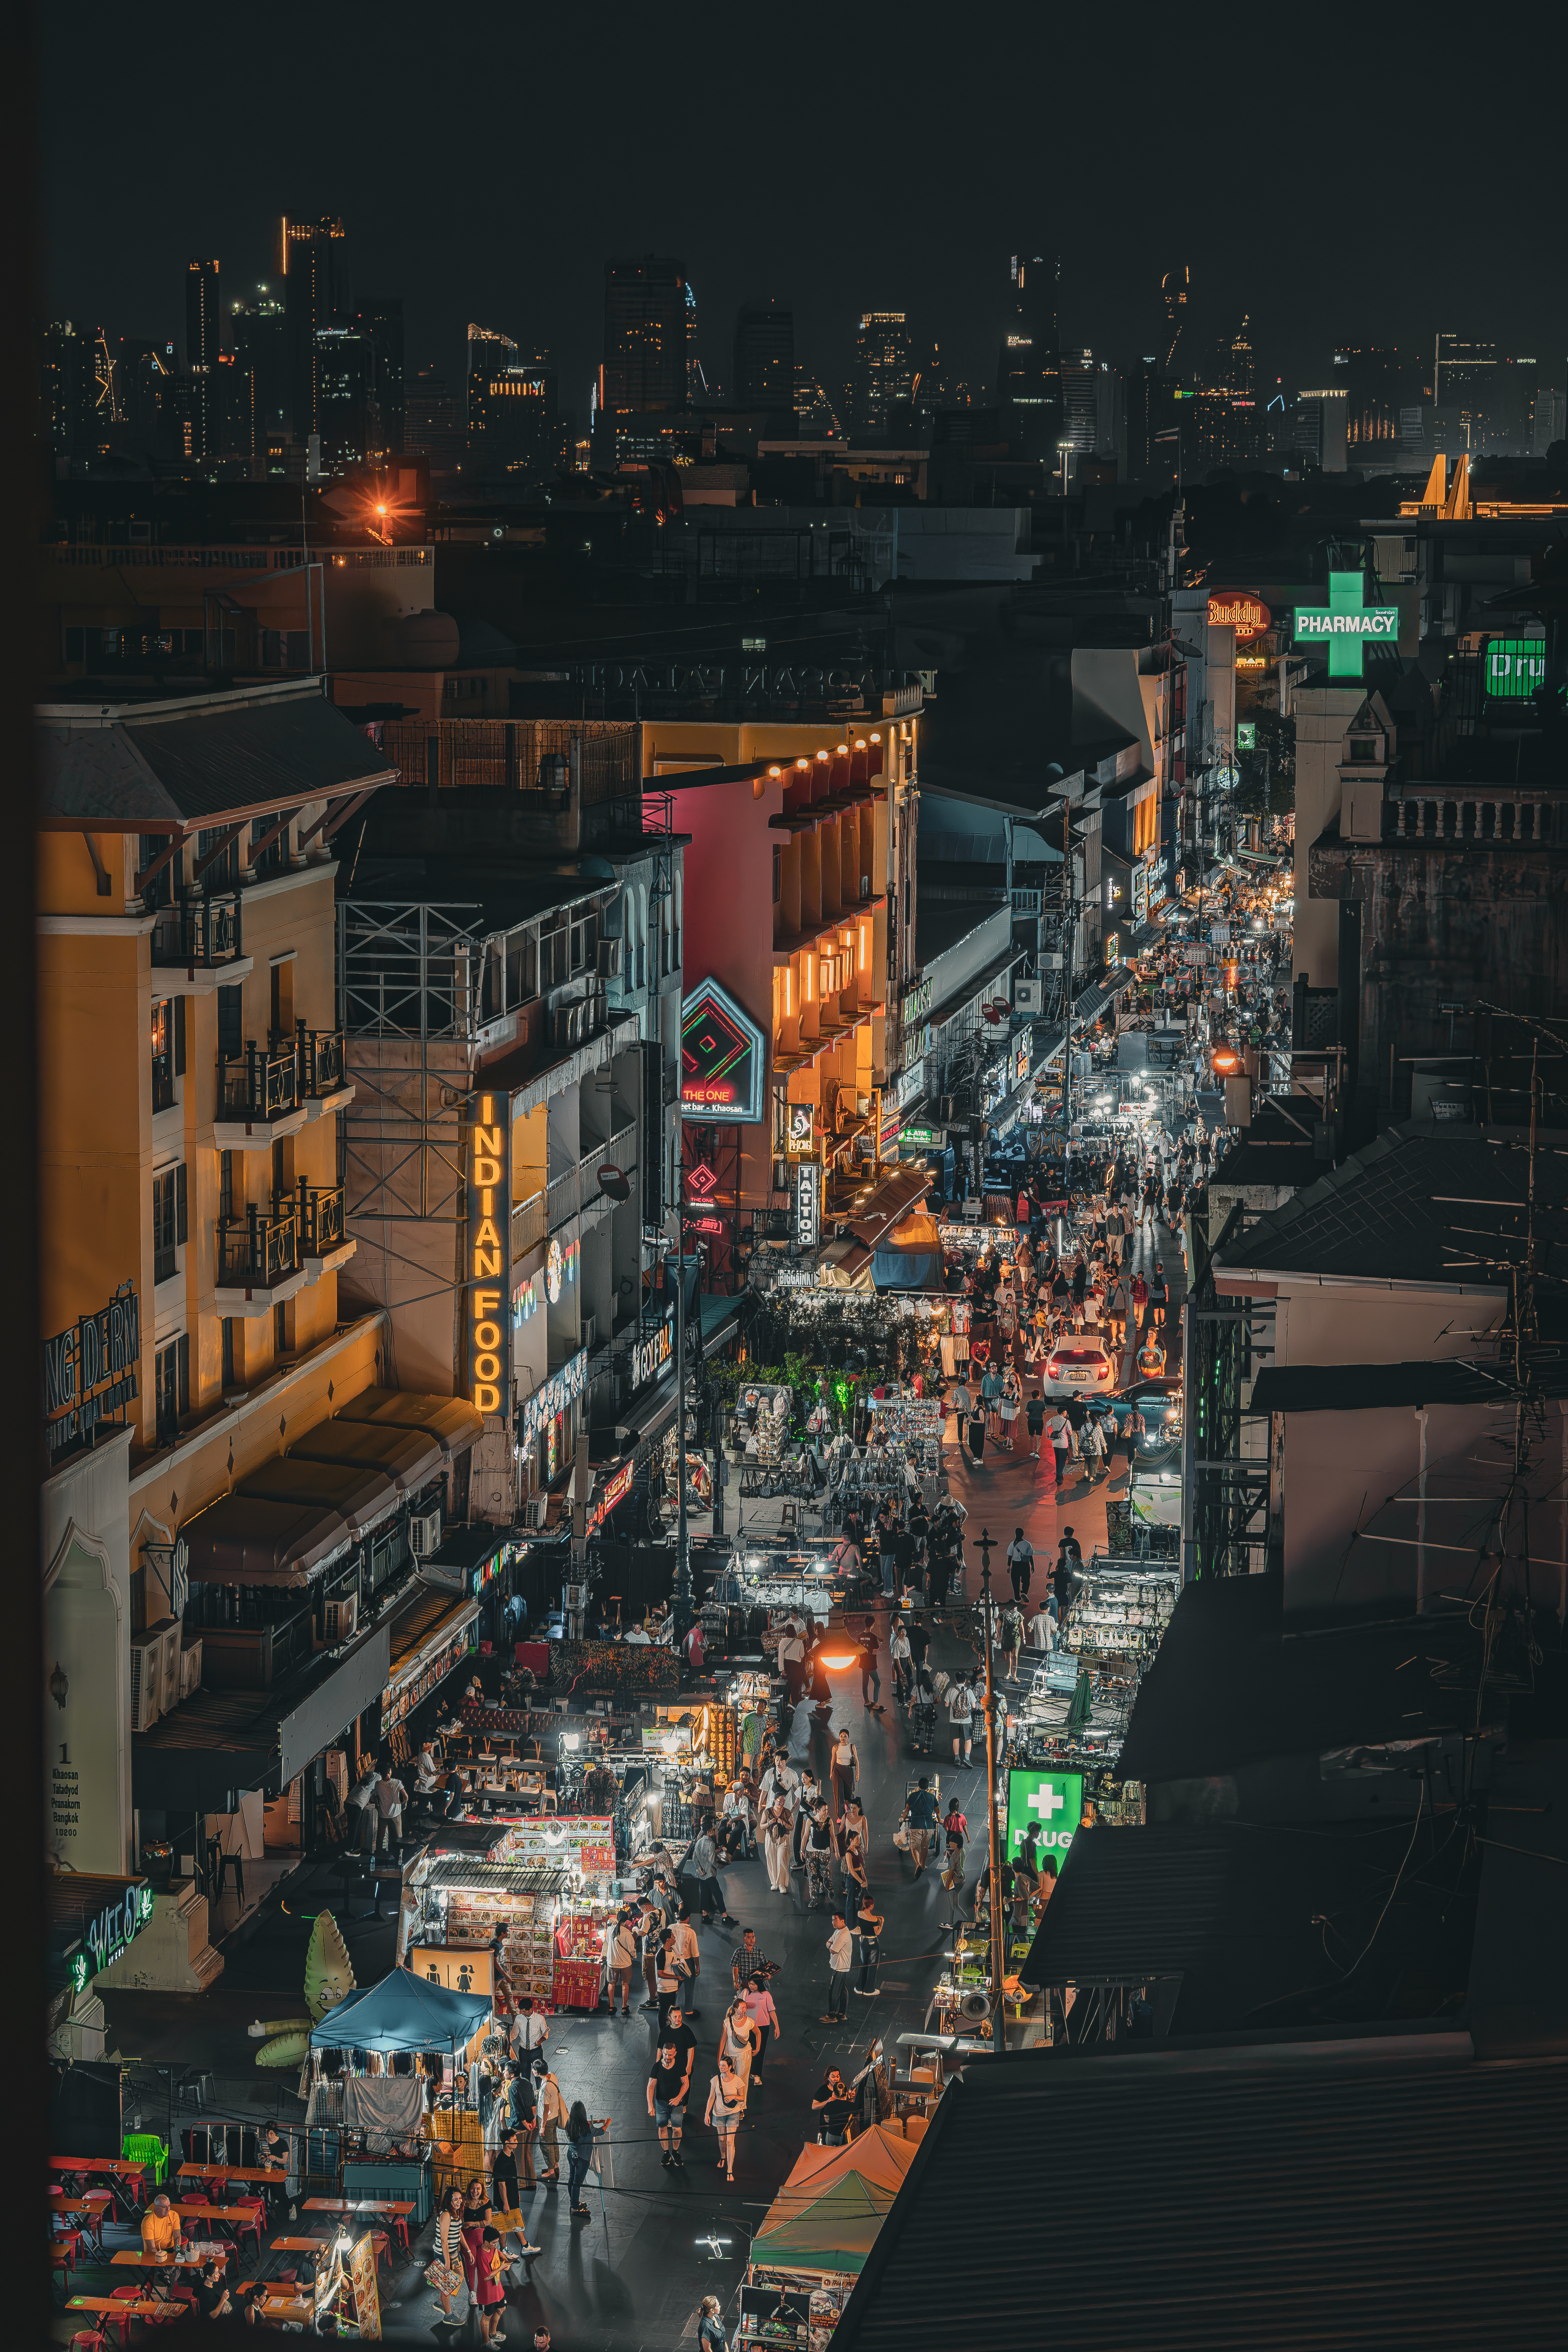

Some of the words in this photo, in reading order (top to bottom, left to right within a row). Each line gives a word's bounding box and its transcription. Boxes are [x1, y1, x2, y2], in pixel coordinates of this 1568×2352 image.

[1208, 601, 1260, 627] Buddy
[1298, 616, 1395, 632] PHARMACY
[683, 1091, 705, 1100] THE
[706, 1091, 730, 1101] ONE
[692, 1103, 705, 1111] bar
[712, 1104, 743, 1113] Khaosan
[474, 1095, 501, 1277] INDIAN
[800, 1167, 812, 1243] TATTOO
[83, 1294, 140, 1392] DERM
[474, 1290, 501, 1412] FOOD
[58, 1742, 72, 1764] 1
[52, 1768, 79, 1780] Khaosan
[52, 1783, 79, 1798] Taladyod
[53, 1811, 79, 1826] Bangkok
[55, 1828, 77, 1837] 10200
